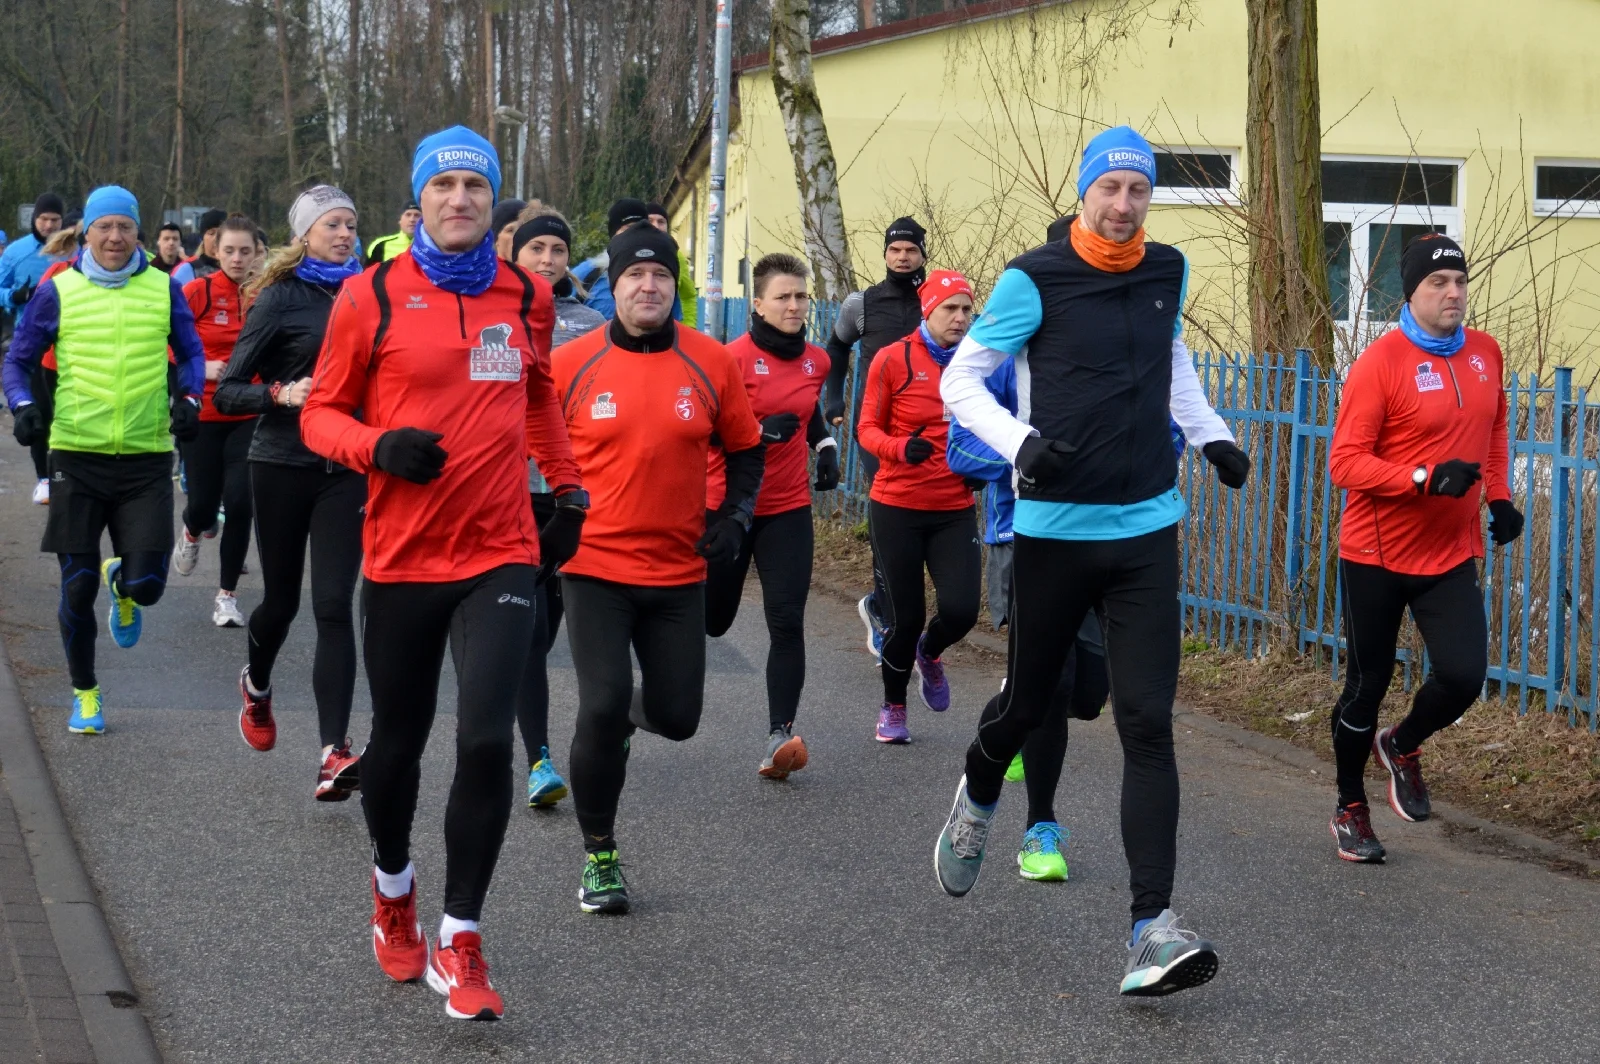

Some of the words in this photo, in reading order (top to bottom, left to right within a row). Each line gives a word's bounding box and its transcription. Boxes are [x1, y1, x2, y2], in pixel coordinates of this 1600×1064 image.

[438, 150, 488, 166] ERDINGER
[1443, 249, 1462, 258] asics
[472, 349, 520, 361] BLOCK
[472, 361, 521, 373] HOUSE
[511, 596, 530, 607] asics
